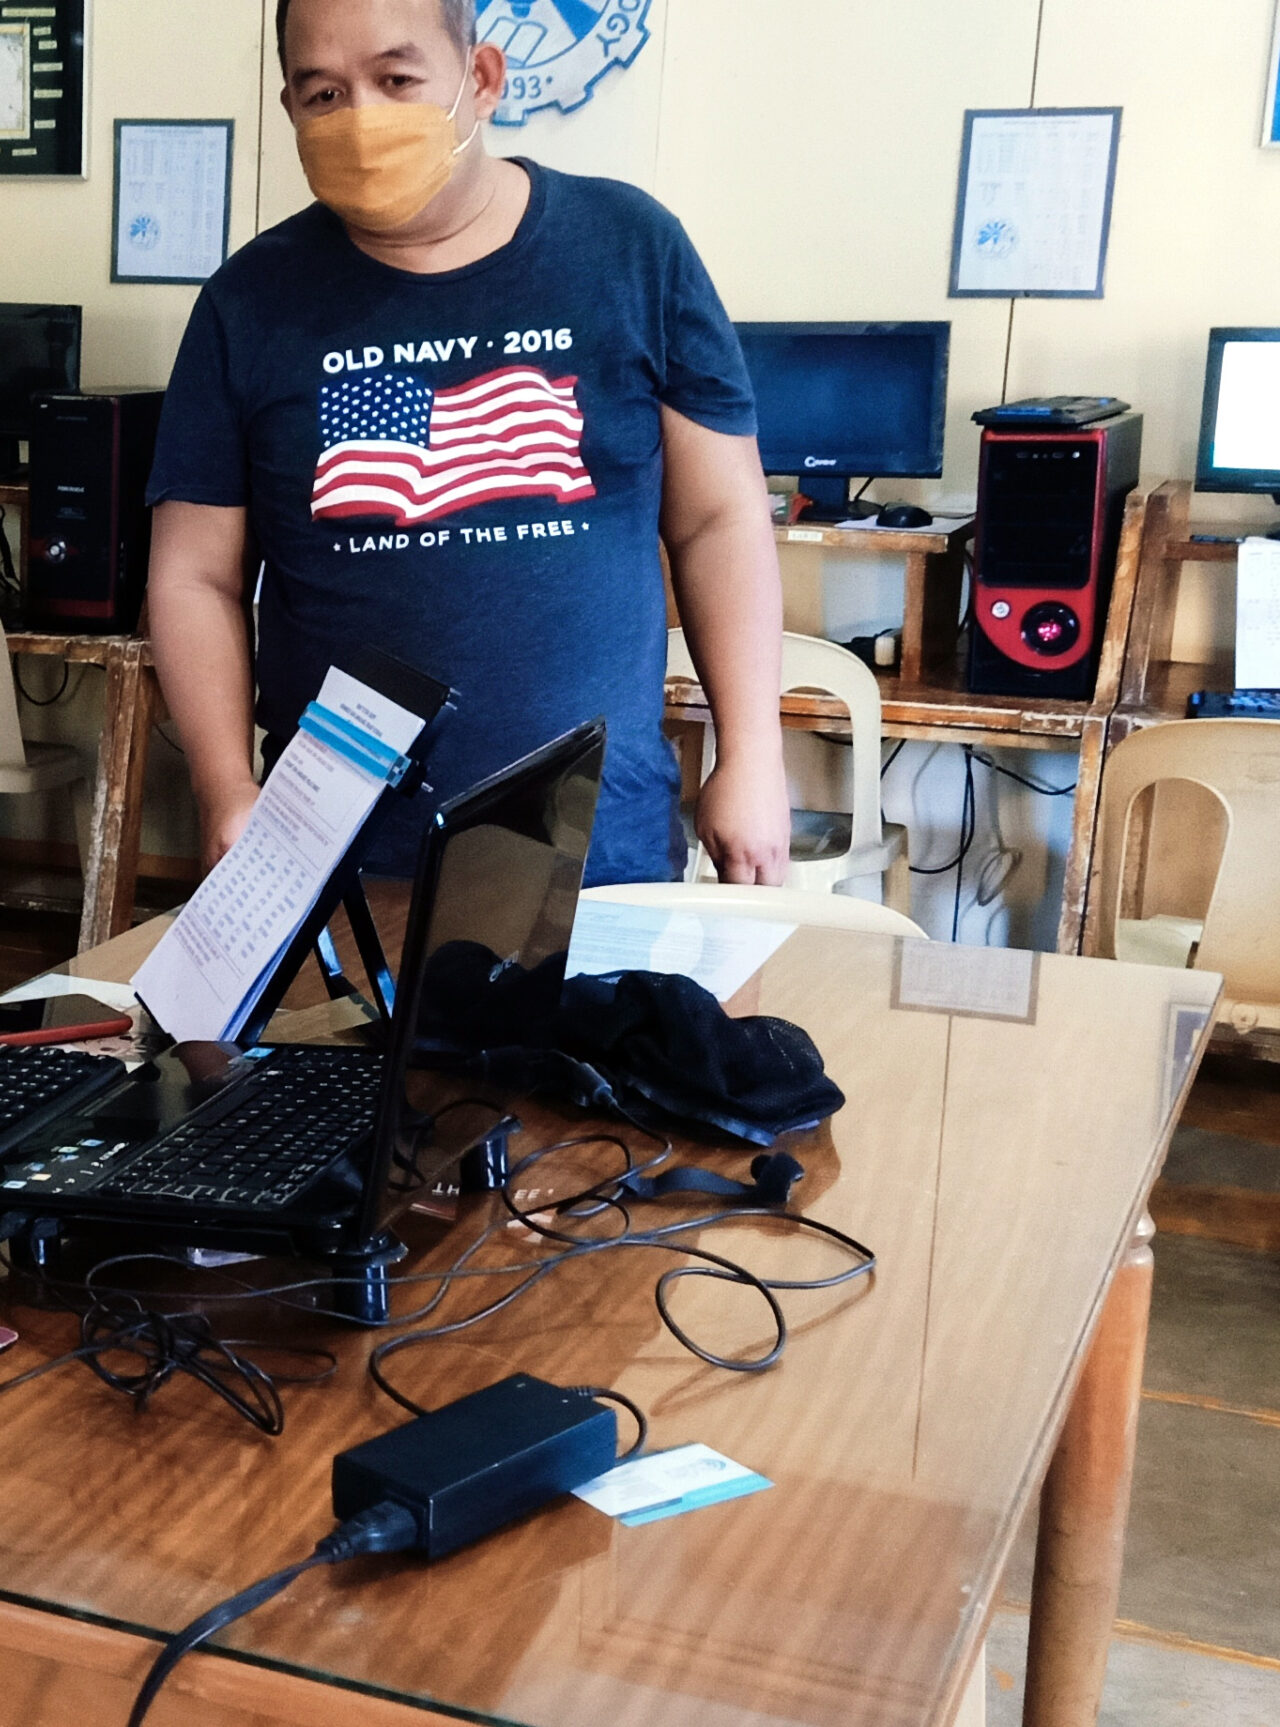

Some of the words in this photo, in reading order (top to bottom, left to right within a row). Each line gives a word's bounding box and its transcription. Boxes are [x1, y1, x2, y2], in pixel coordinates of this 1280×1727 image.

[322, 346, 384, 374] OLD
[394, 336, 478, 363] NAVY
[503, 328, 573, 354] 2016
[349, 534, 410, 553] LAND
[420, 530, 450, 547] OF
[460, 527, 507, 544] THE
[516, 520, 575, 540] FREE
